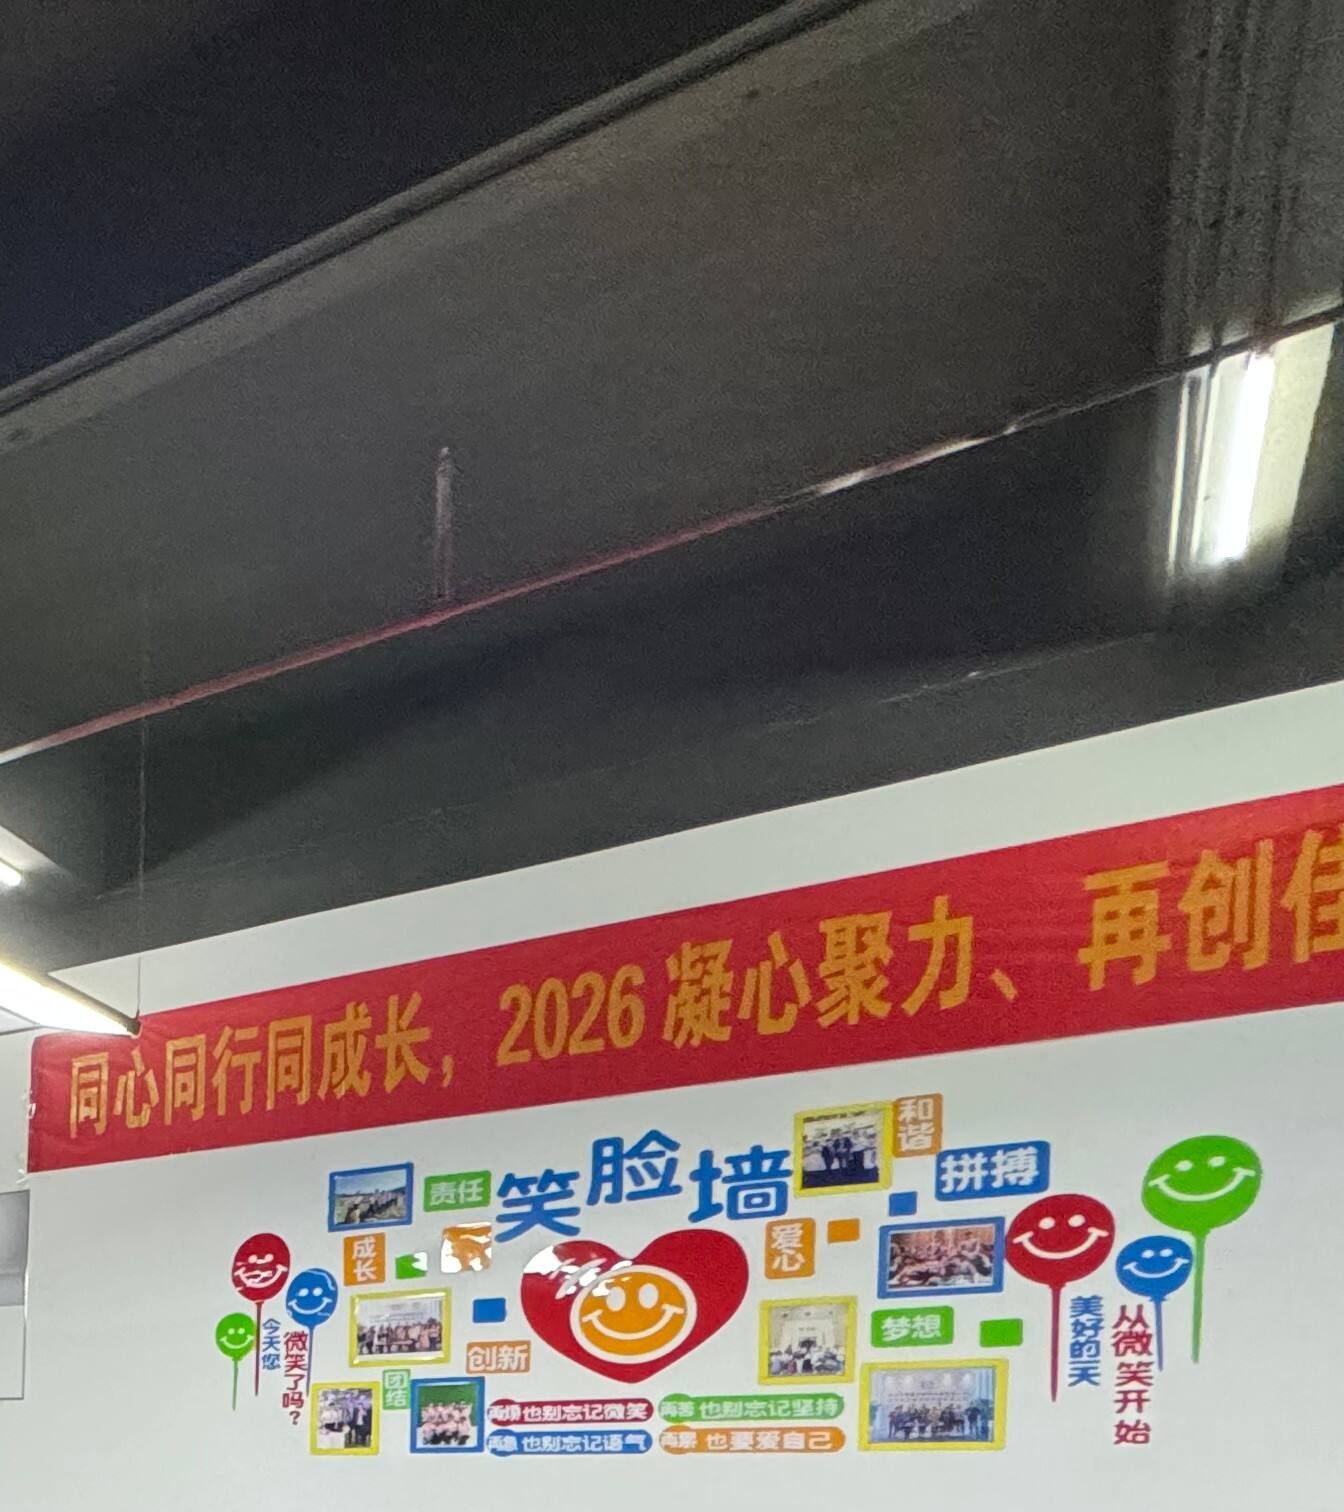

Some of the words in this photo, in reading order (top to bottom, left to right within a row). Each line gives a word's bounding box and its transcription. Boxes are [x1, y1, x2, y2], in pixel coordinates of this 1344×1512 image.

[497, 964, 645, 1067] 2026
[897, 1097, 935, 1152] 和谐
[430, 1178, 484, 1206] 责任
[495, 1129, 794, 1243] 笑脸墙
[940, 1146, 1040, 1193] 拼搏
[352, 1236, 377, 1282] 成长
[771, 1223, 806, 1272] 爱心
[262, 1318, 281, 1370] 今天您
[881, 1314, 942, 1342] 梦想
[1068, 1295, 1104, 1388] 美好的一天
[467, 1345, 528, 1371] 创新
[1111, 1303, 1155, 1445] 从微笑开始
[385, 1373, 408, 1407] 团结
